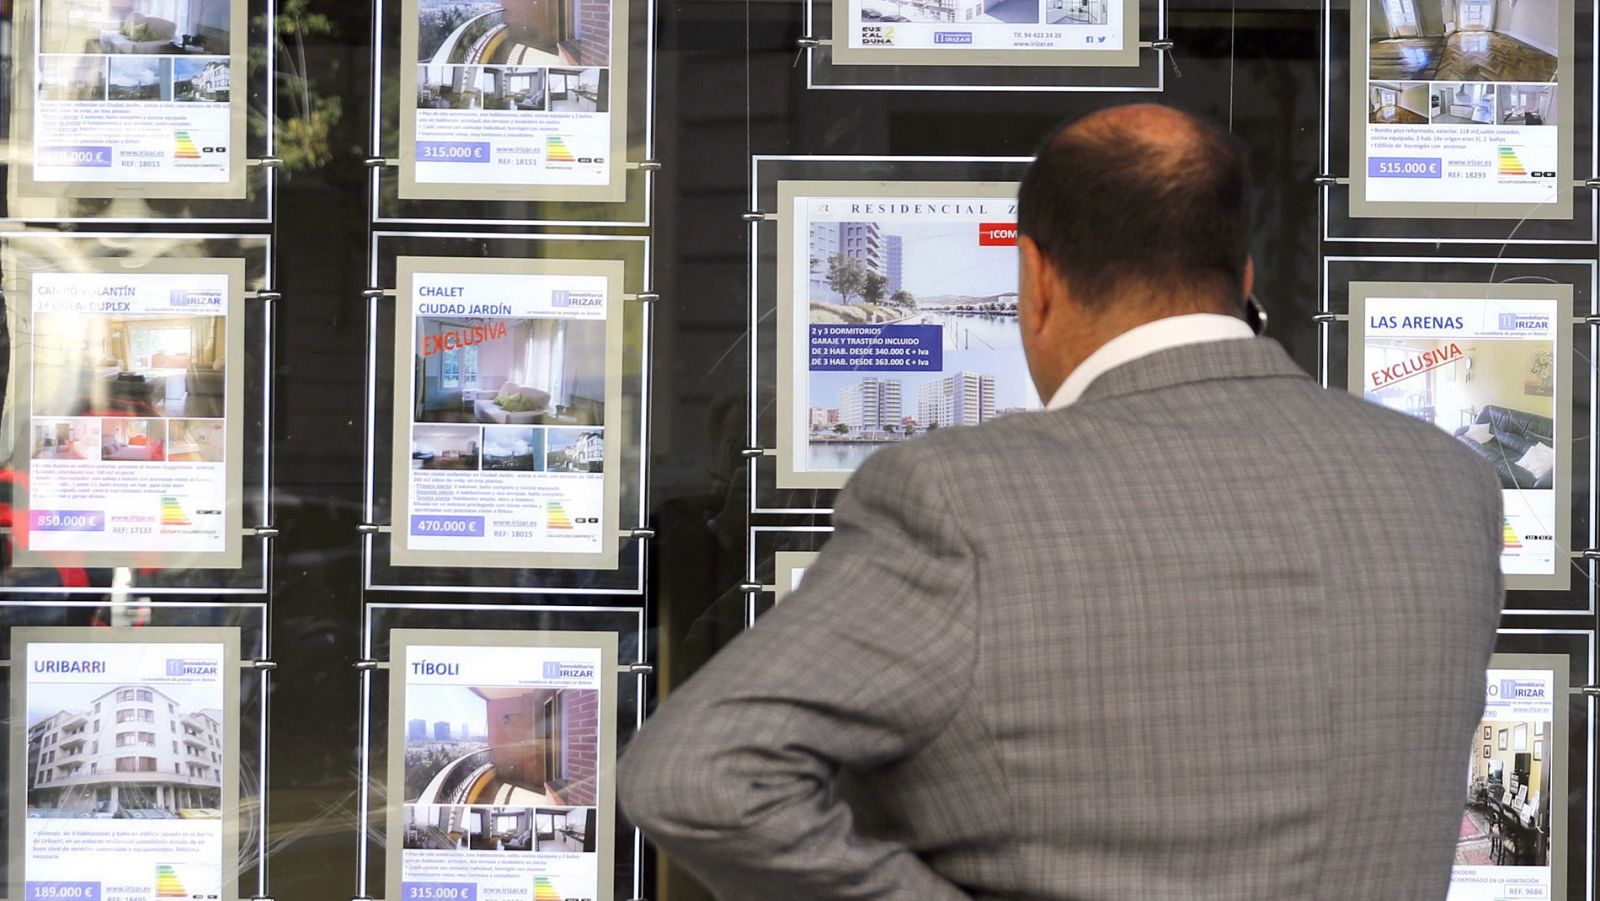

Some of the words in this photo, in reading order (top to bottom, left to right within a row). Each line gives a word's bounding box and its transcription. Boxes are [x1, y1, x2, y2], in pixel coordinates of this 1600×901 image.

[424, 146, 471, 157] 315.000
[474, 147, 482, 158] €
[1380, 162, 1426, 173] 515.000
[1429, 162, 1437, 173] €
[852, 204, 988, 214] RESIDENCIAL
[419, 286, 464, 297] CHALET
[419, 304, 465, 314] CIUDAD
[468, 302, 511, 315] JARDÍN
[1370, 316, 1397, 329] LAS
[1402, 316, 1463, 329] ARENAS
[422, 322, 507, 356] EXCLUSIVA
[1371, 342, 1462, 386] EXCLUSIVA
[38, 515, 85, 527] 850.000
[89, 516, 97, 526] €
[418, 520, 466, 532] 470.000
[468, 521, 476, 532] €
[35, 660, 106, 673] URIBARRI
[412, 659, 459, 675] TÍBOLI
[34, 887, 81, 898] 189.000
[85, 887, 93, 898] €
[410, 887, 458, 898] 315.000
[461, 888, 468, 899] €
